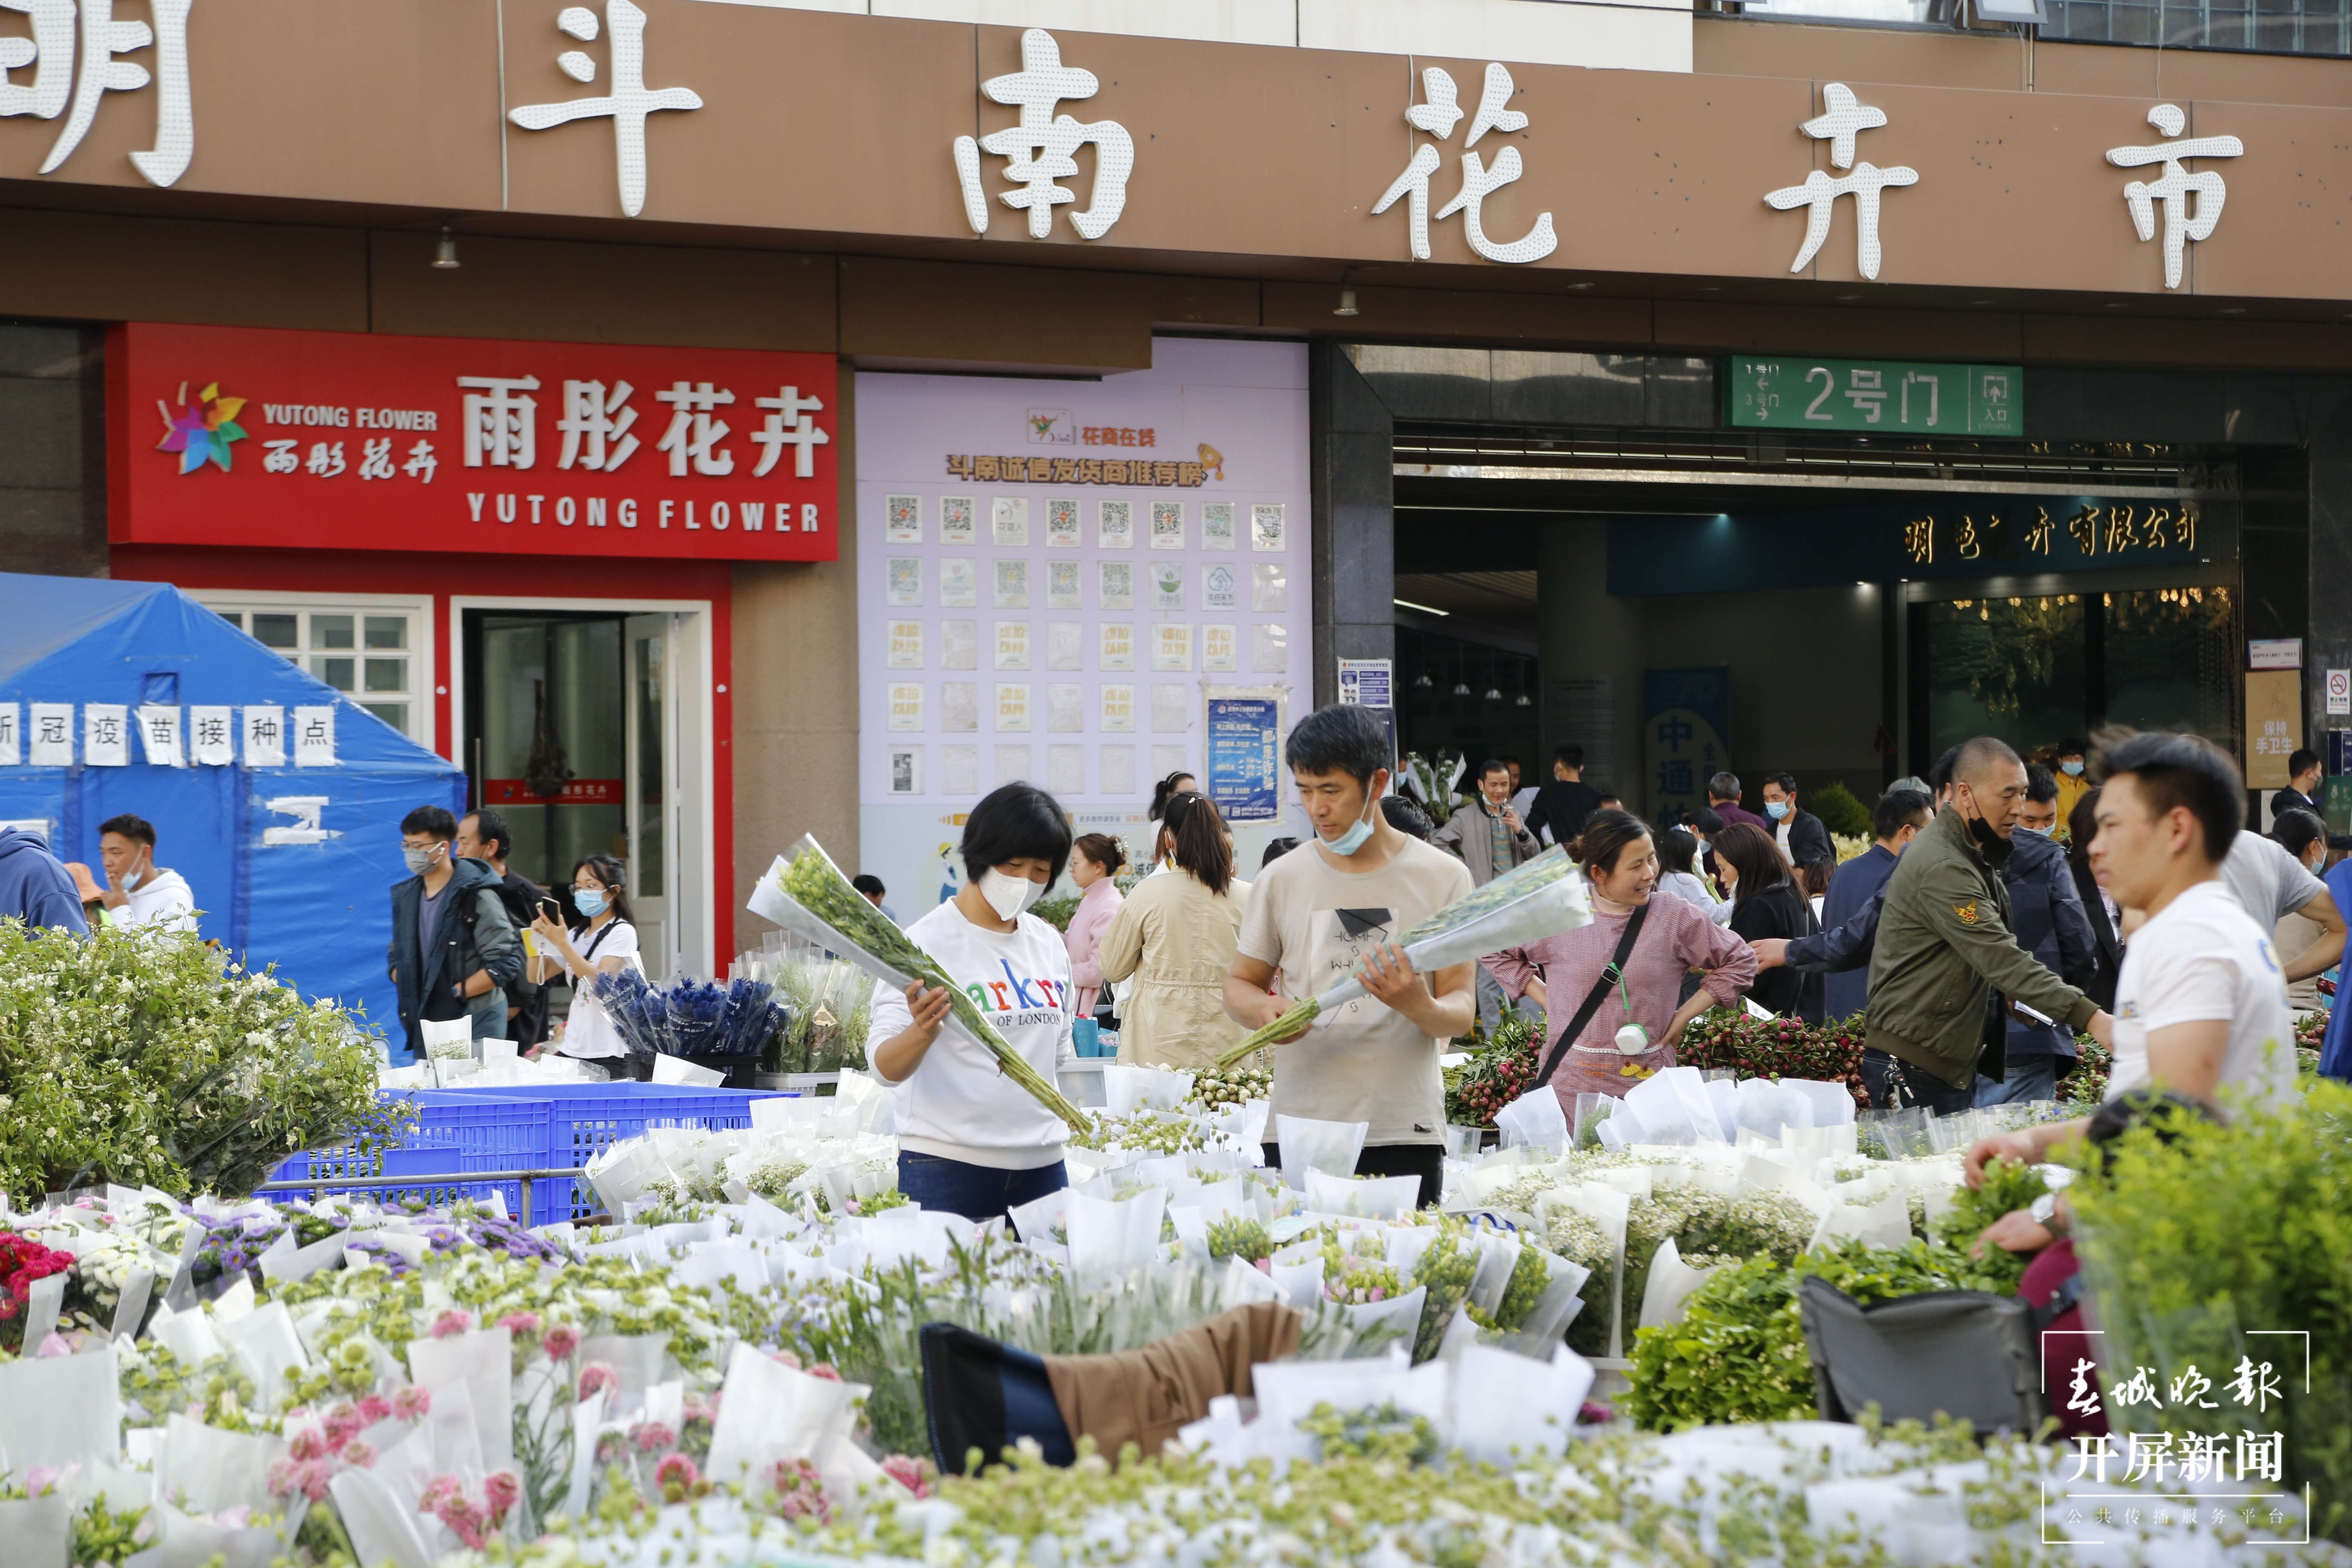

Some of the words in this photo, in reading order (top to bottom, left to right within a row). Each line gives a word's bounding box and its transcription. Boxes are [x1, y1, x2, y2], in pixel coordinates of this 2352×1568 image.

[1746, 363, 1779, 376] 1号门
[1746, 393, 1779, 408] 3号门
[1804, 367, 1938, 426] 2号门
[263, 403, 349, 428] YUTONG
[356, 408, 438, 431] FLOWER
[456, 374, 830, 478] 雨彤花卉
[1984, 408, 2007, 422] 入口
[1082, 426, 1156, 448] 花商在线
[262, 437, 438, 484] 雨彤花卉
[946, 454, 1205, 487] 斗南诚信发货商推荐榜
[467, 493, 638, 528] YUTONG
[659, 500, 819, 533] FLOWER
[2264, 720, 2287, 736] 保持
[2256, 737, 2294, 755] 手卫生
[997, 1016, 1012, 1027] OF
[1018, 1013, 1061, 1026] LONDON
